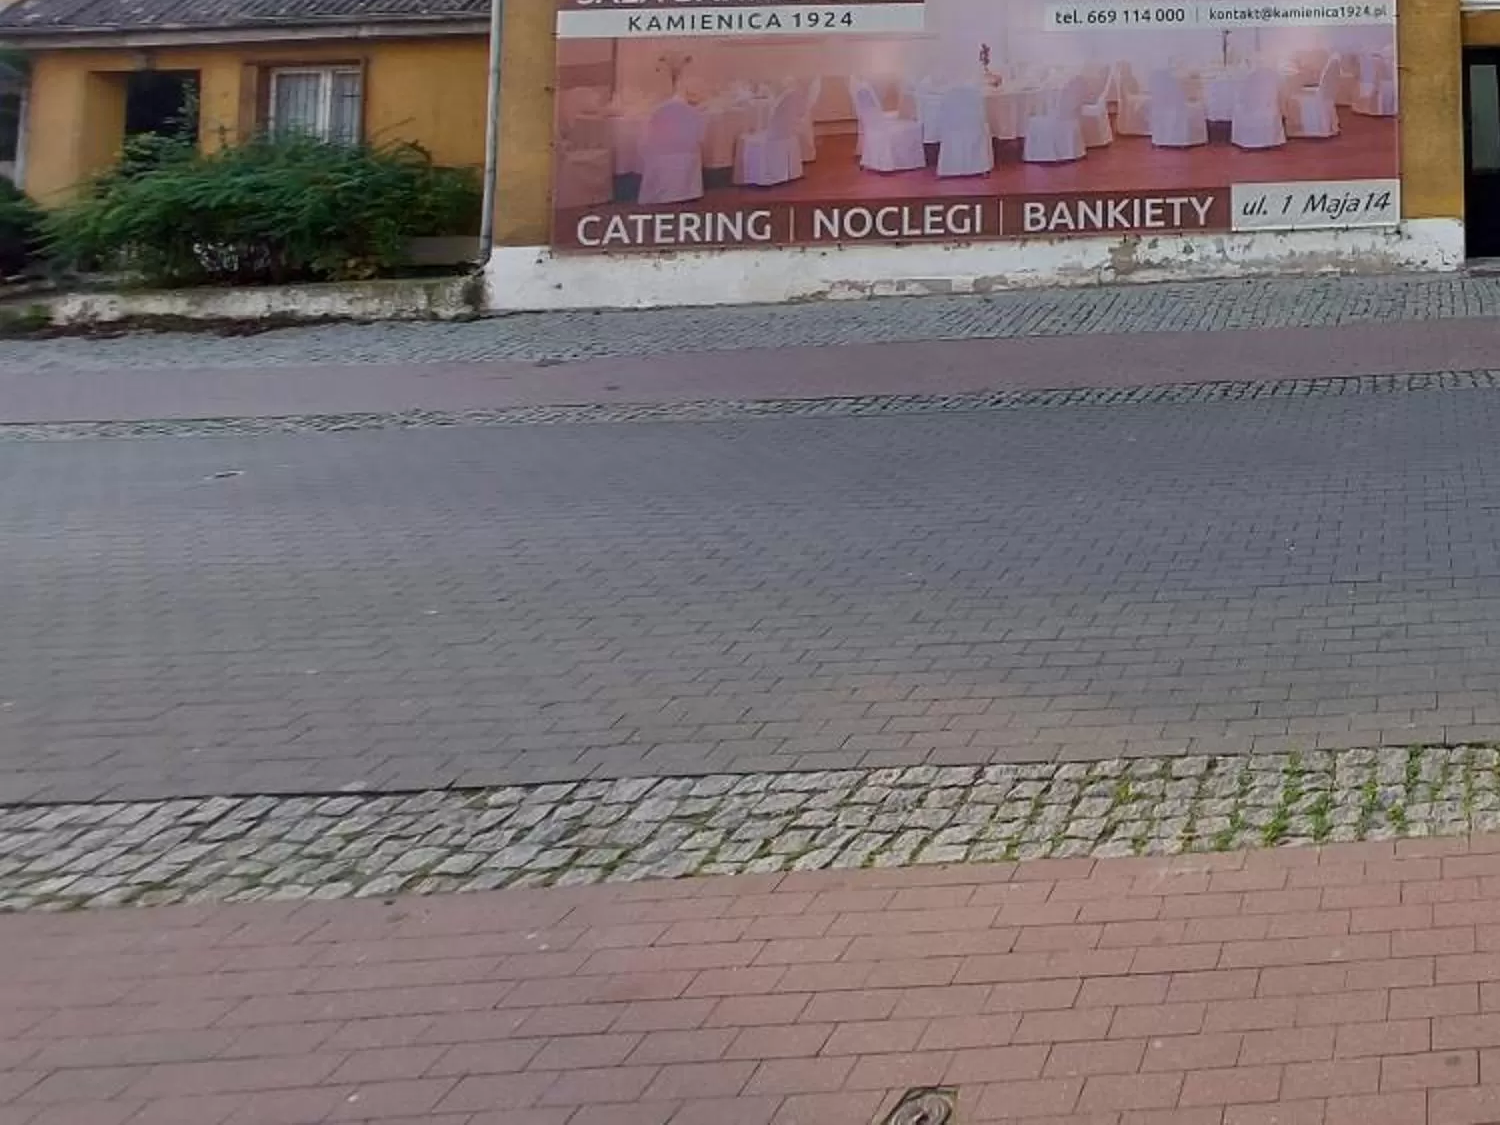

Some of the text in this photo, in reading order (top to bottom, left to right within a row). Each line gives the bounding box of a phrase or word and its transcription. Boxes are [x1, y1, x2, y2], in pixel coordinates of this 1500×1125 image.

[628, 11, 854, 33] KAMIENICA 1924
[1055, 8, 1186, 24] tel. 669 114 000
[1209, 5, 1387, 21] kontakt@kamienica1924.pl
[1023, 196, 1216, 233] BANKIETY
[1242, 190, 1391, 220] ul. 1 Maja 14
[576, 210, 772, 247] CATERING
[812, 203, 983, 240] NOCLEGI
